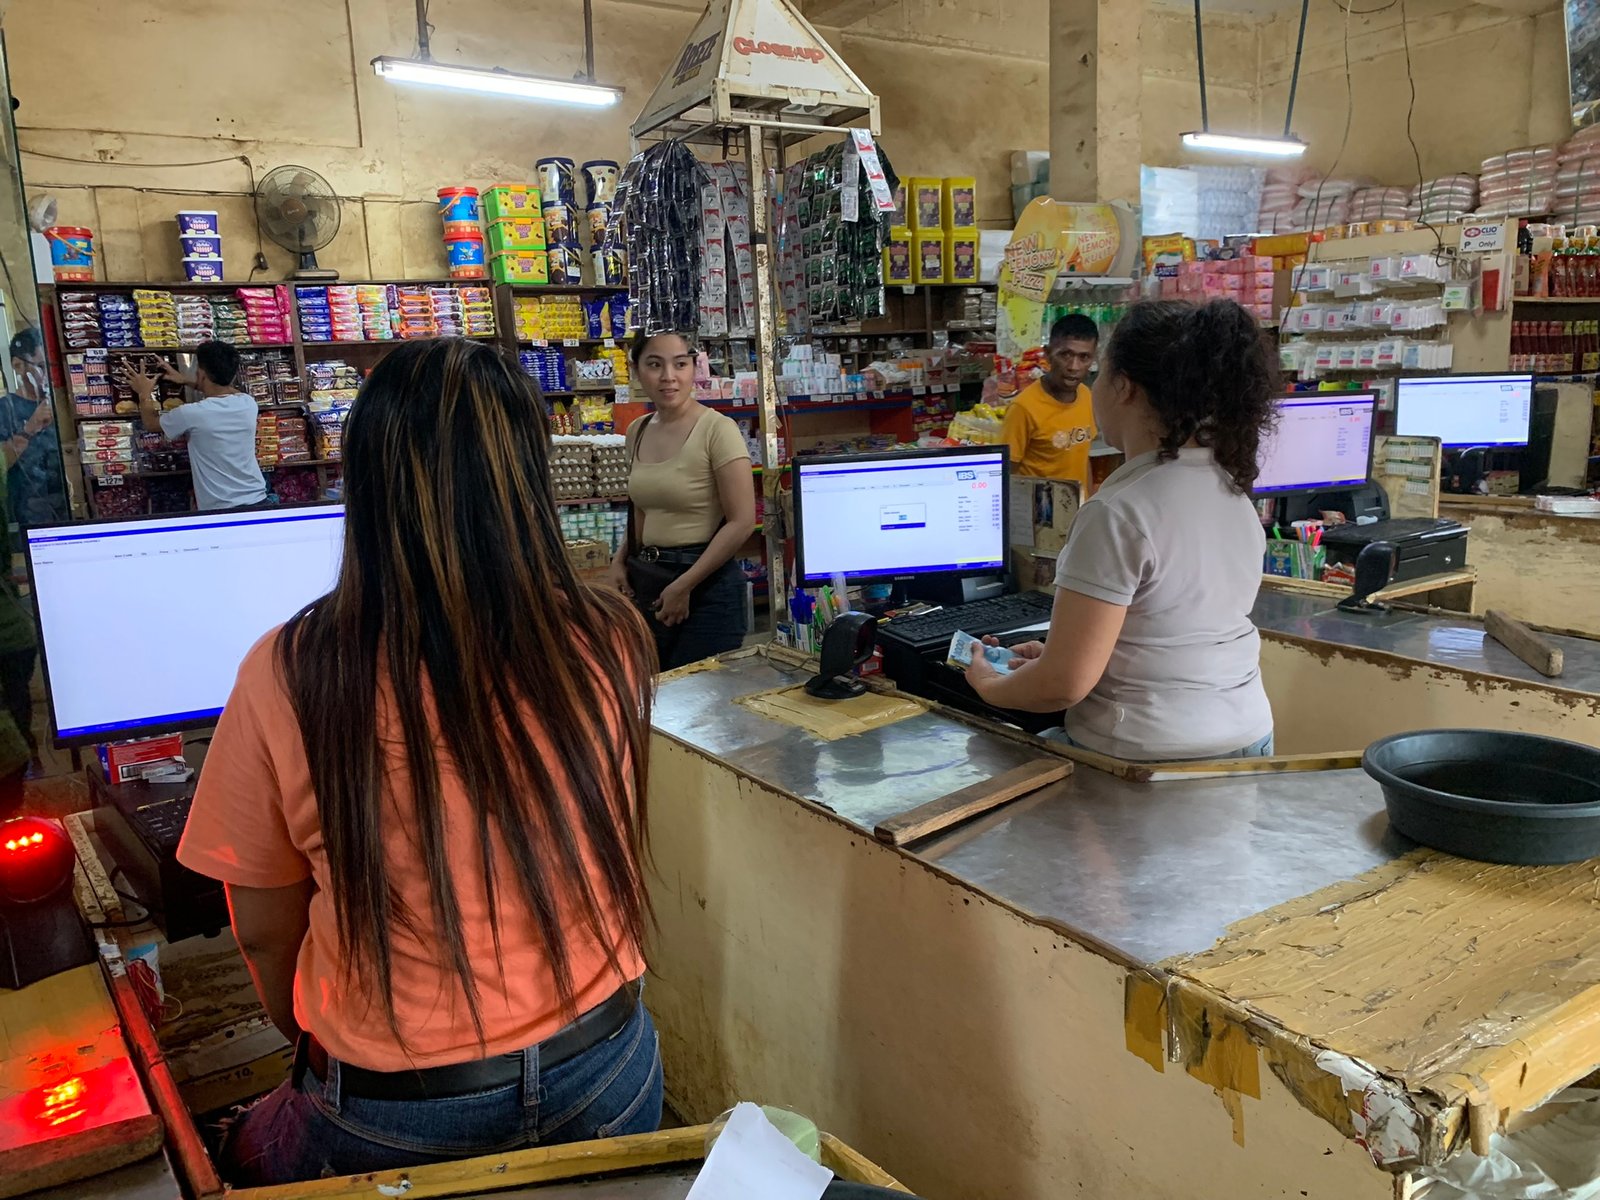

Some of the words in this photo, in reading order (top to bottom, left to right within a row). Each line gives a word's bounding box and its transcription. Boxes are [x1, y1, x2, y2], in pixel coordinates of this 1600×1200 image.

[1481, 226, 1498, 234] CLIO
[1005, 232, 1038, 258] NEW
[1082, 236, 1116, 254] LEMONY
[1009, 248, 1057, 272] LEMONY
